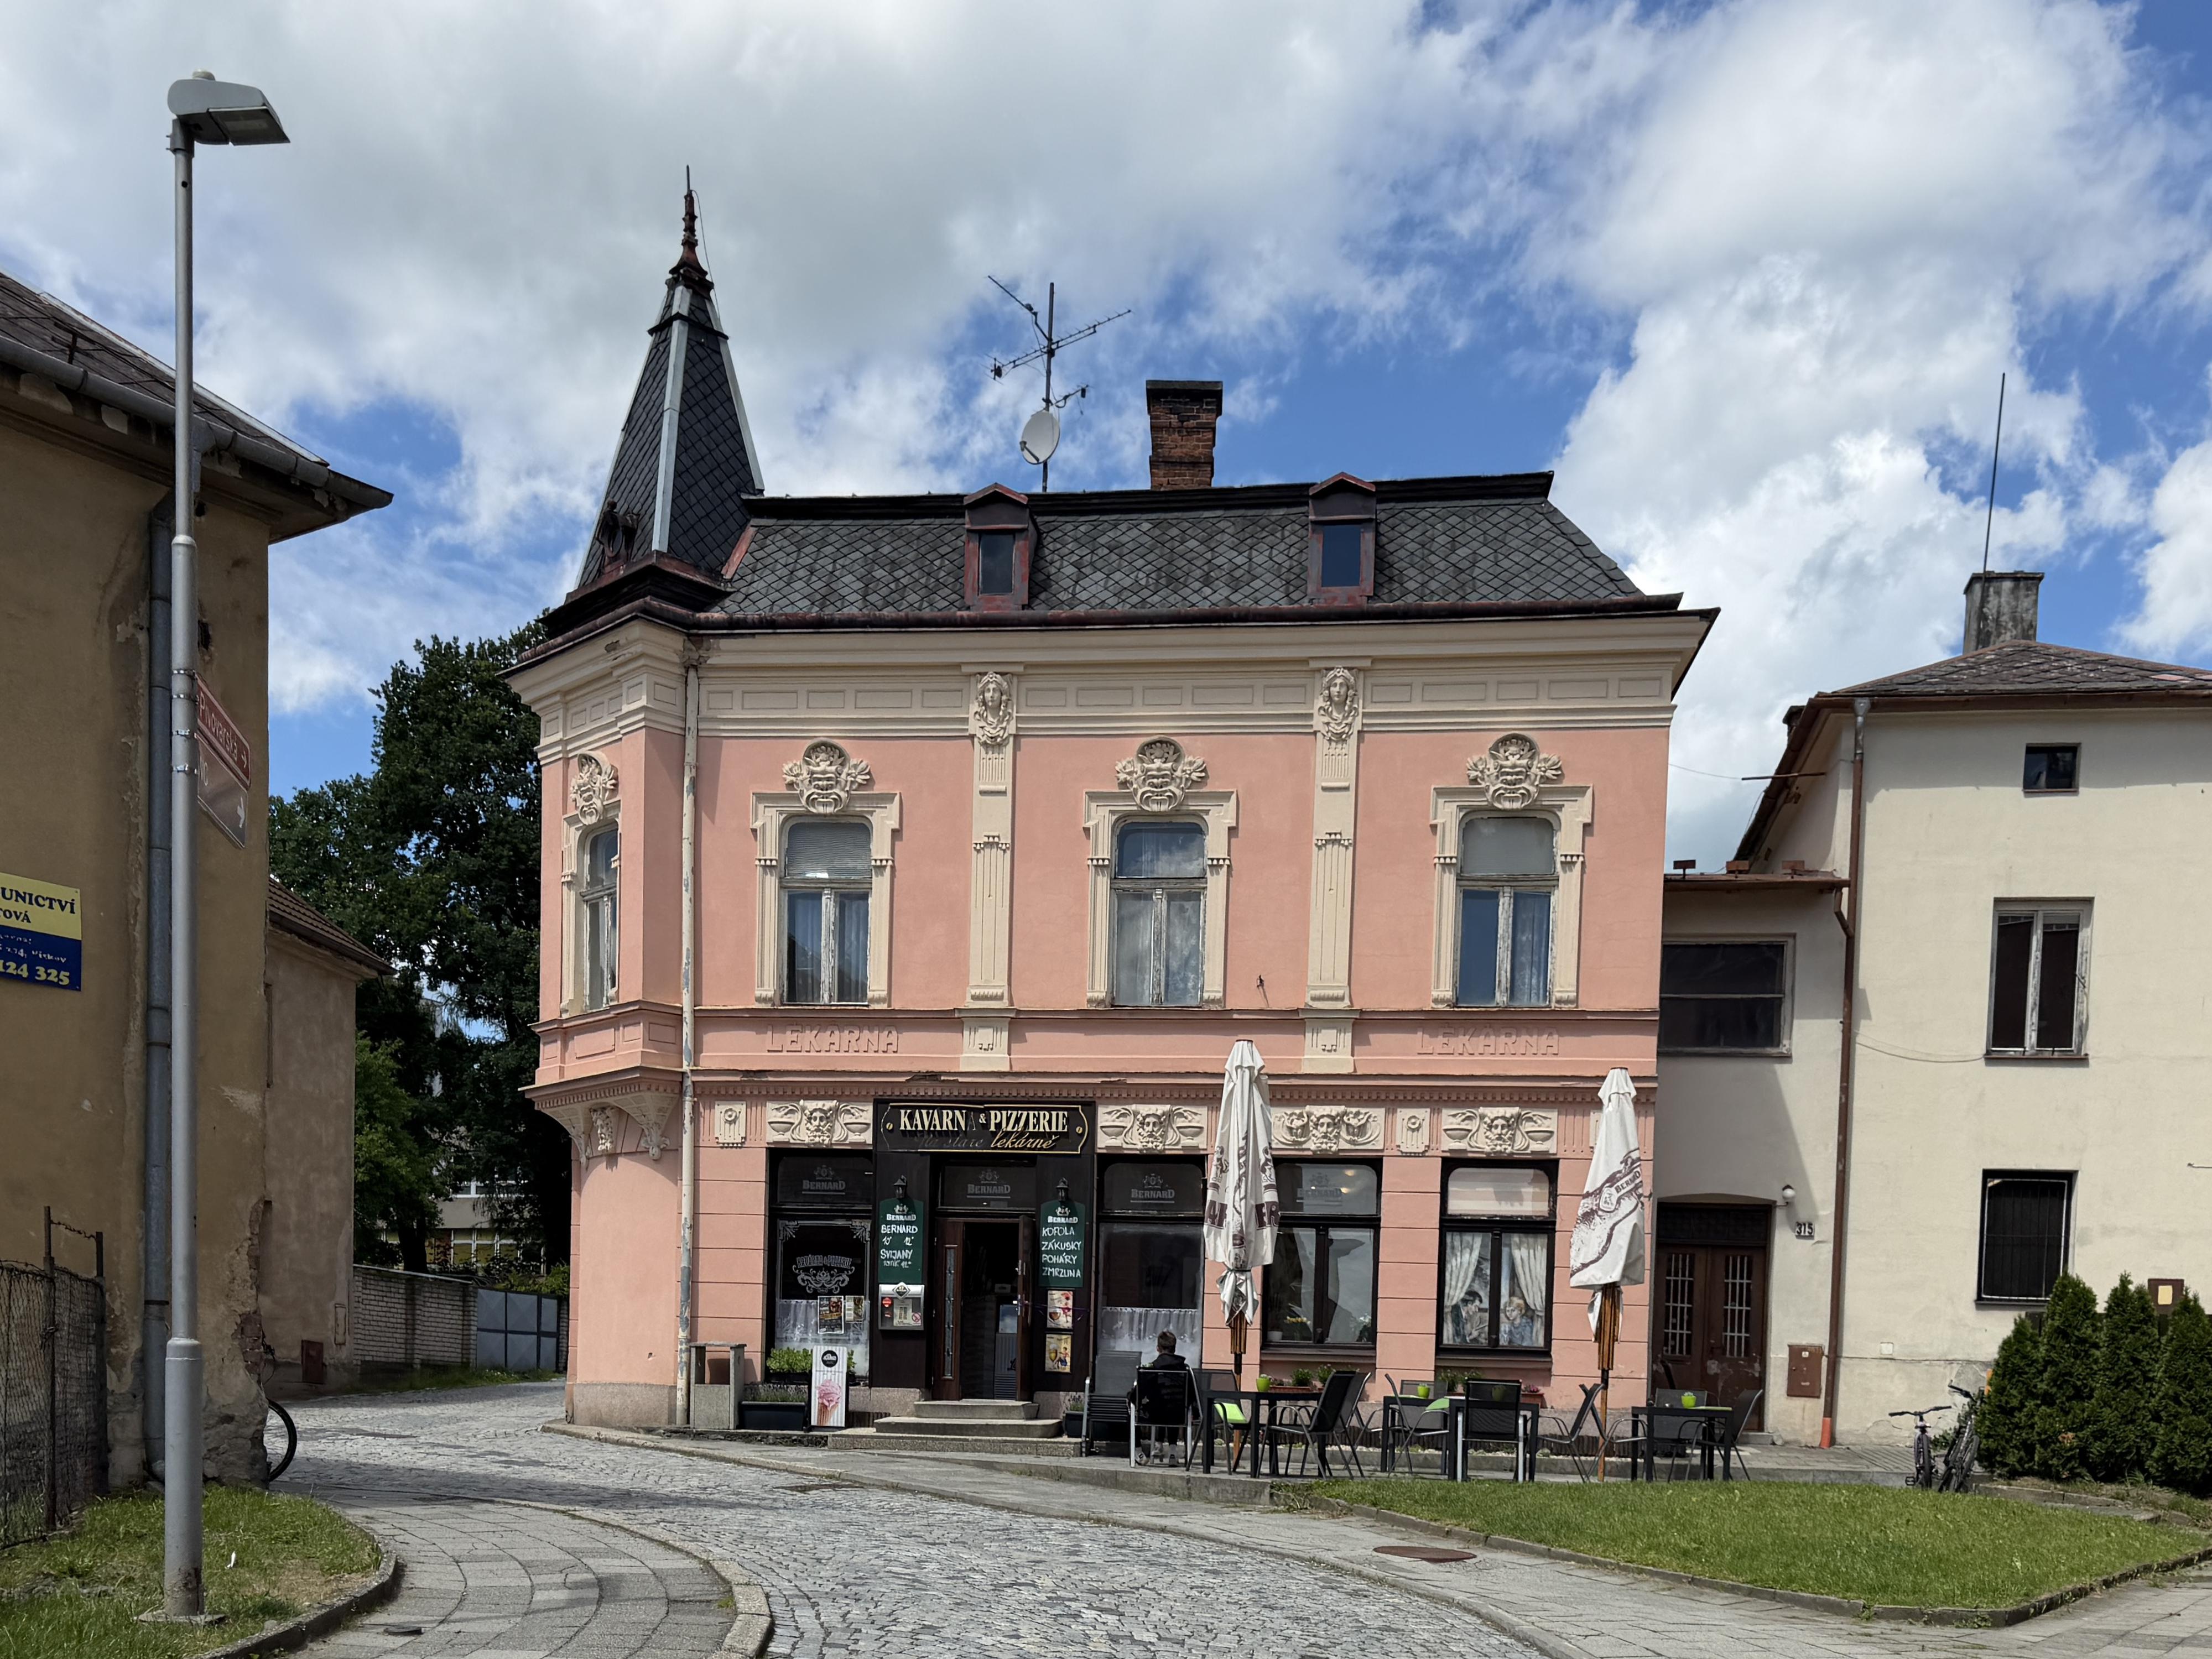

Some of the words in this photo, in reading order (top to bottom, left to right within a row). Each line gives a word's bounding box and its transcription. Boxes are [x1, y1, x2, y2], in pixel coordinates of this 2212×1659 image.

[35, 966, 70, 985] 325
[979, 1113, 986, 1124] &
[989, 1110, 1068, 1132] PIZZERIE
[802, 1180, 846, 1191] BERNARD
[967, 1184, 1011, 1194] BERNARD
[1131, 1188, 1175, 1199] BERNARD
[881, 1224, 918, 1234] BERNARD
[1042, 1227, 1075, 1237] KOFOLA
[1796, 1222, 1813, 1235] 315
[1041, 1239, 1082, 1250] ZÁKUSKY
[880, 1249, 913, 1260] SVIJANY
[1042, 1252, 1078, 1264] POHÁRY
[1042, 1266, 1081, 1278] ZMRZLINA
